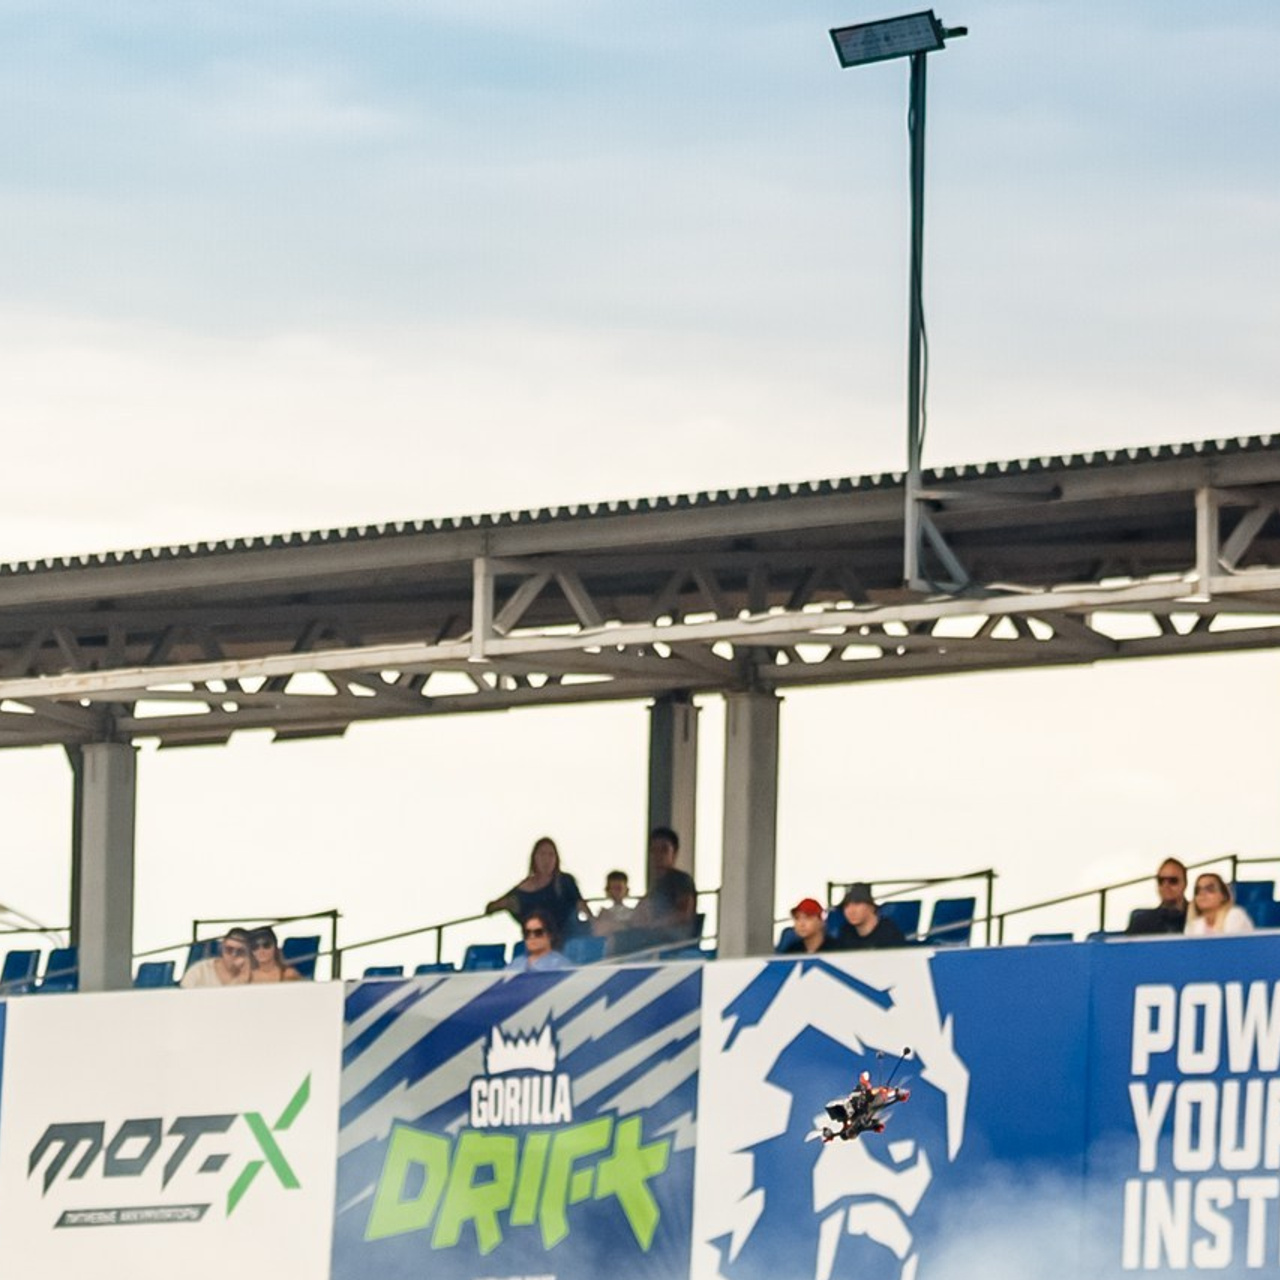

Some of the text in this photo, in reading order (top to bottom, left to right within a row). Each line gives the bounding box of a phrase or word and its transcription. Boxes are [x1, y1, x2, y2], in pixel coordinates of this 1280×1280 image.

[1131, 981, 1280, 1076] POW
[471, 1074, 572, 1128] GORILLA
[1122, 1177, 1280, 1270] INST
